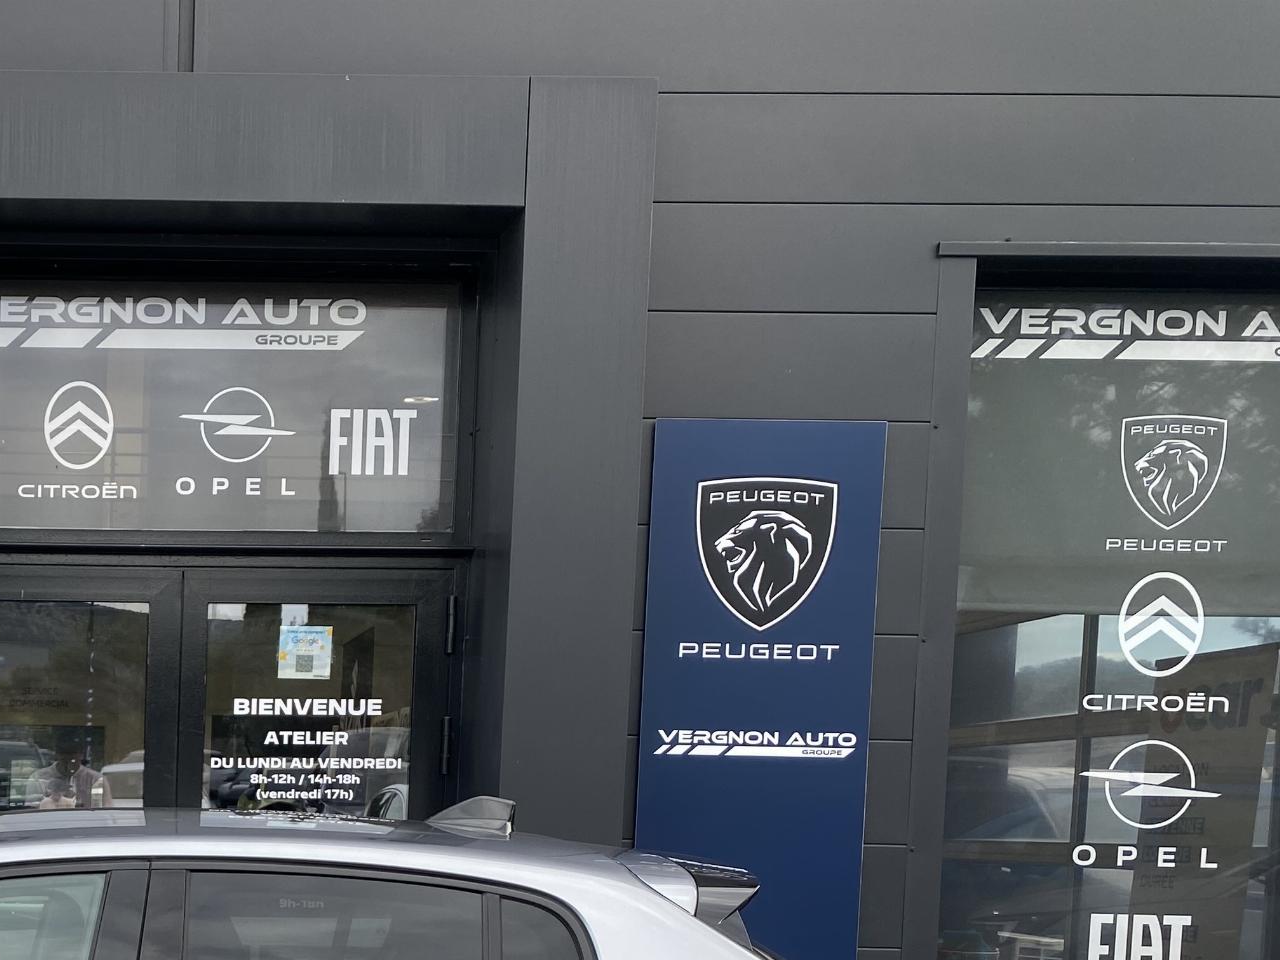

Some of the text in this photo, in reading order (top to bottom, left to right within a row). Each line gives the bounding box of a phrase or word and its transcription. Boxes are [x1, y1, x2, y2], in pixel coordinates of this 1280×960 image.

[221, 297, 368, 327] AUTO
[979, 307, 1227, 337] VERGNON
[255, 334, 338, 346] GROUPE
[1130, 423, 1219, 437] PEUGEOT
[328, 408, 418, 476] FIAT
[17, 481, 137, 499] CITROËN
[175, 476, 296, 496] OPEL
[709, 490, 825, 506] PEUGEOT
[1105, 538, 1228, 553] PEUGEOT
[678, 642, 840, 661] PEUGEOT
[233, 697, 383, 716] BIENVENUE
[1082, 692, 1230, 713] CITROËN
[263, 730, 349, 746] ATELIER
[657, 728, 857, 747] VERGNON AUTO
[801, 749, 843, 757] GROUPE
[210, 757, 402, 770] DU LUNDI AU VENDREDI
[249, 773, 361, 786] 8h-12h / 14h-18h
[255, 788, 354, 801] (vendredi 17h)
[1072, 844, 1218, 872] OPEL
